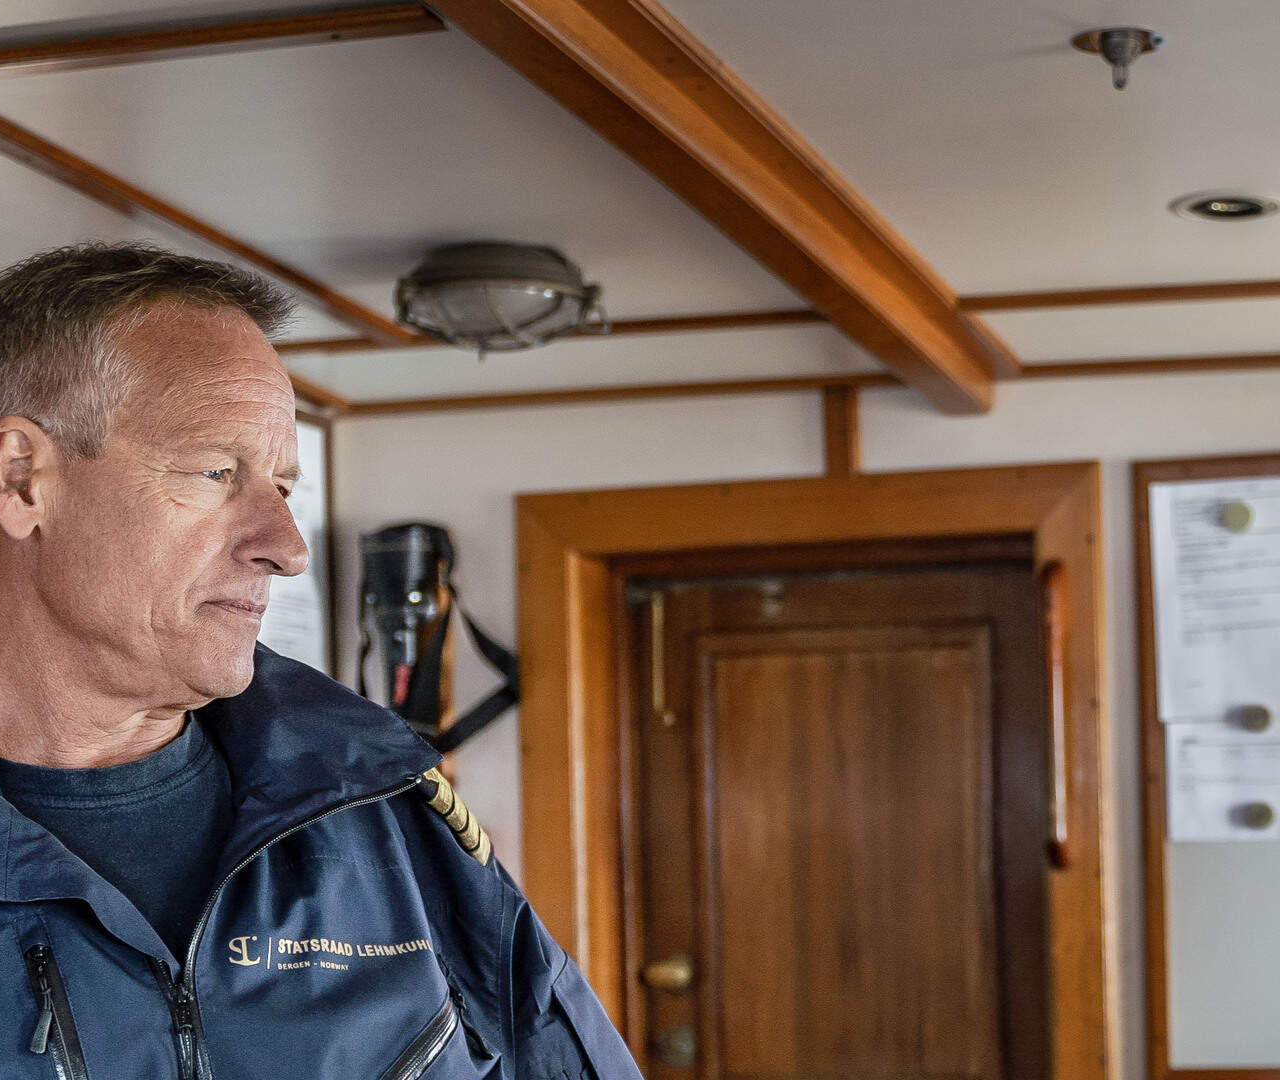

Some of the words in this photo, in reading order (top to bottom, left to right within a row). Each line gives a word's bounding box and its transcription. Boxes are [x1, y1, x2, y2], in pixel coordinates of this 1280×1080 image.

[277, 938, 354, 957] STATSRAAD
[277, 960, 311, 971] BERGEN
[320, 960, 350, 971] NORWAY
